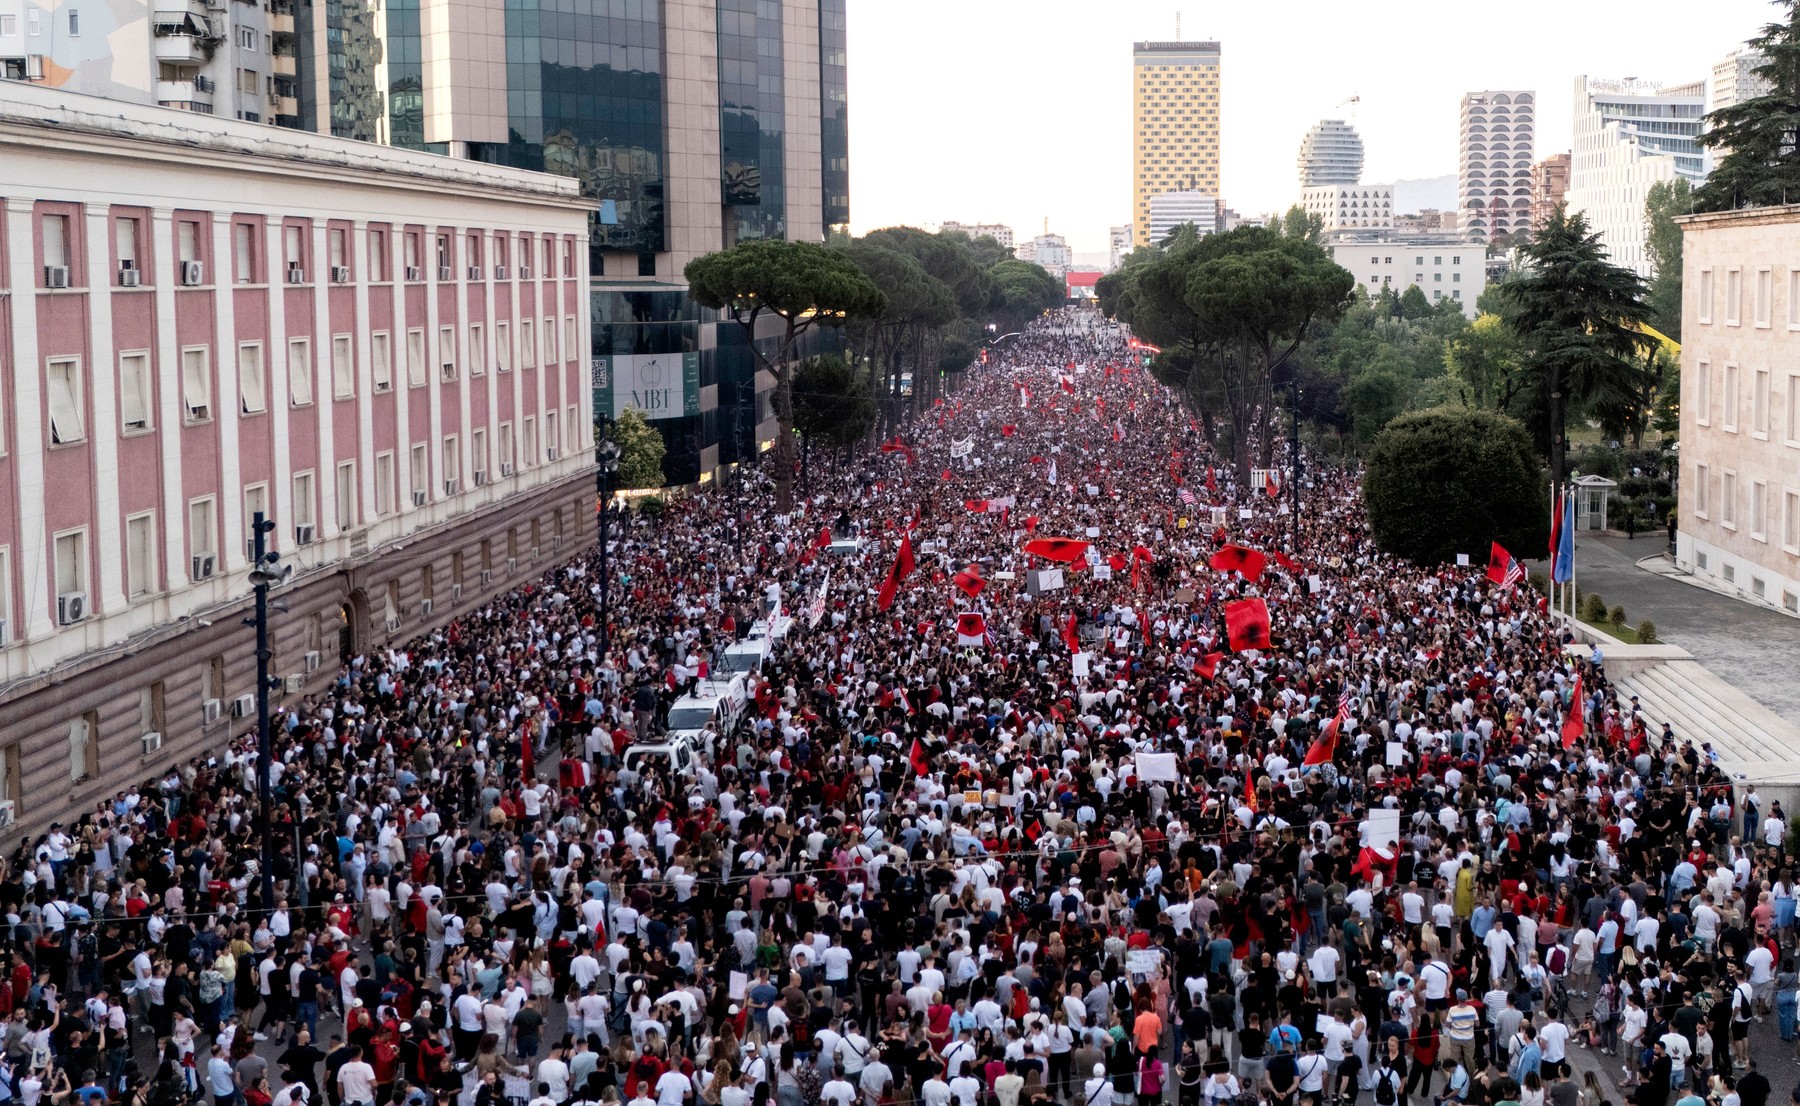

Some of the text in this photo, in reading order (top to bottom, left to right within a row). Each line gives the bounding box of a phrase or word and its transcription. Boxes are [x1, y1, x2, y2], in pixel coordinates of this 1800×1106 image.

[1636, 80, 1664, 89] BANK
[632, 388, 672, 410] MBT
[795, 1028, 807, 1041] 10
